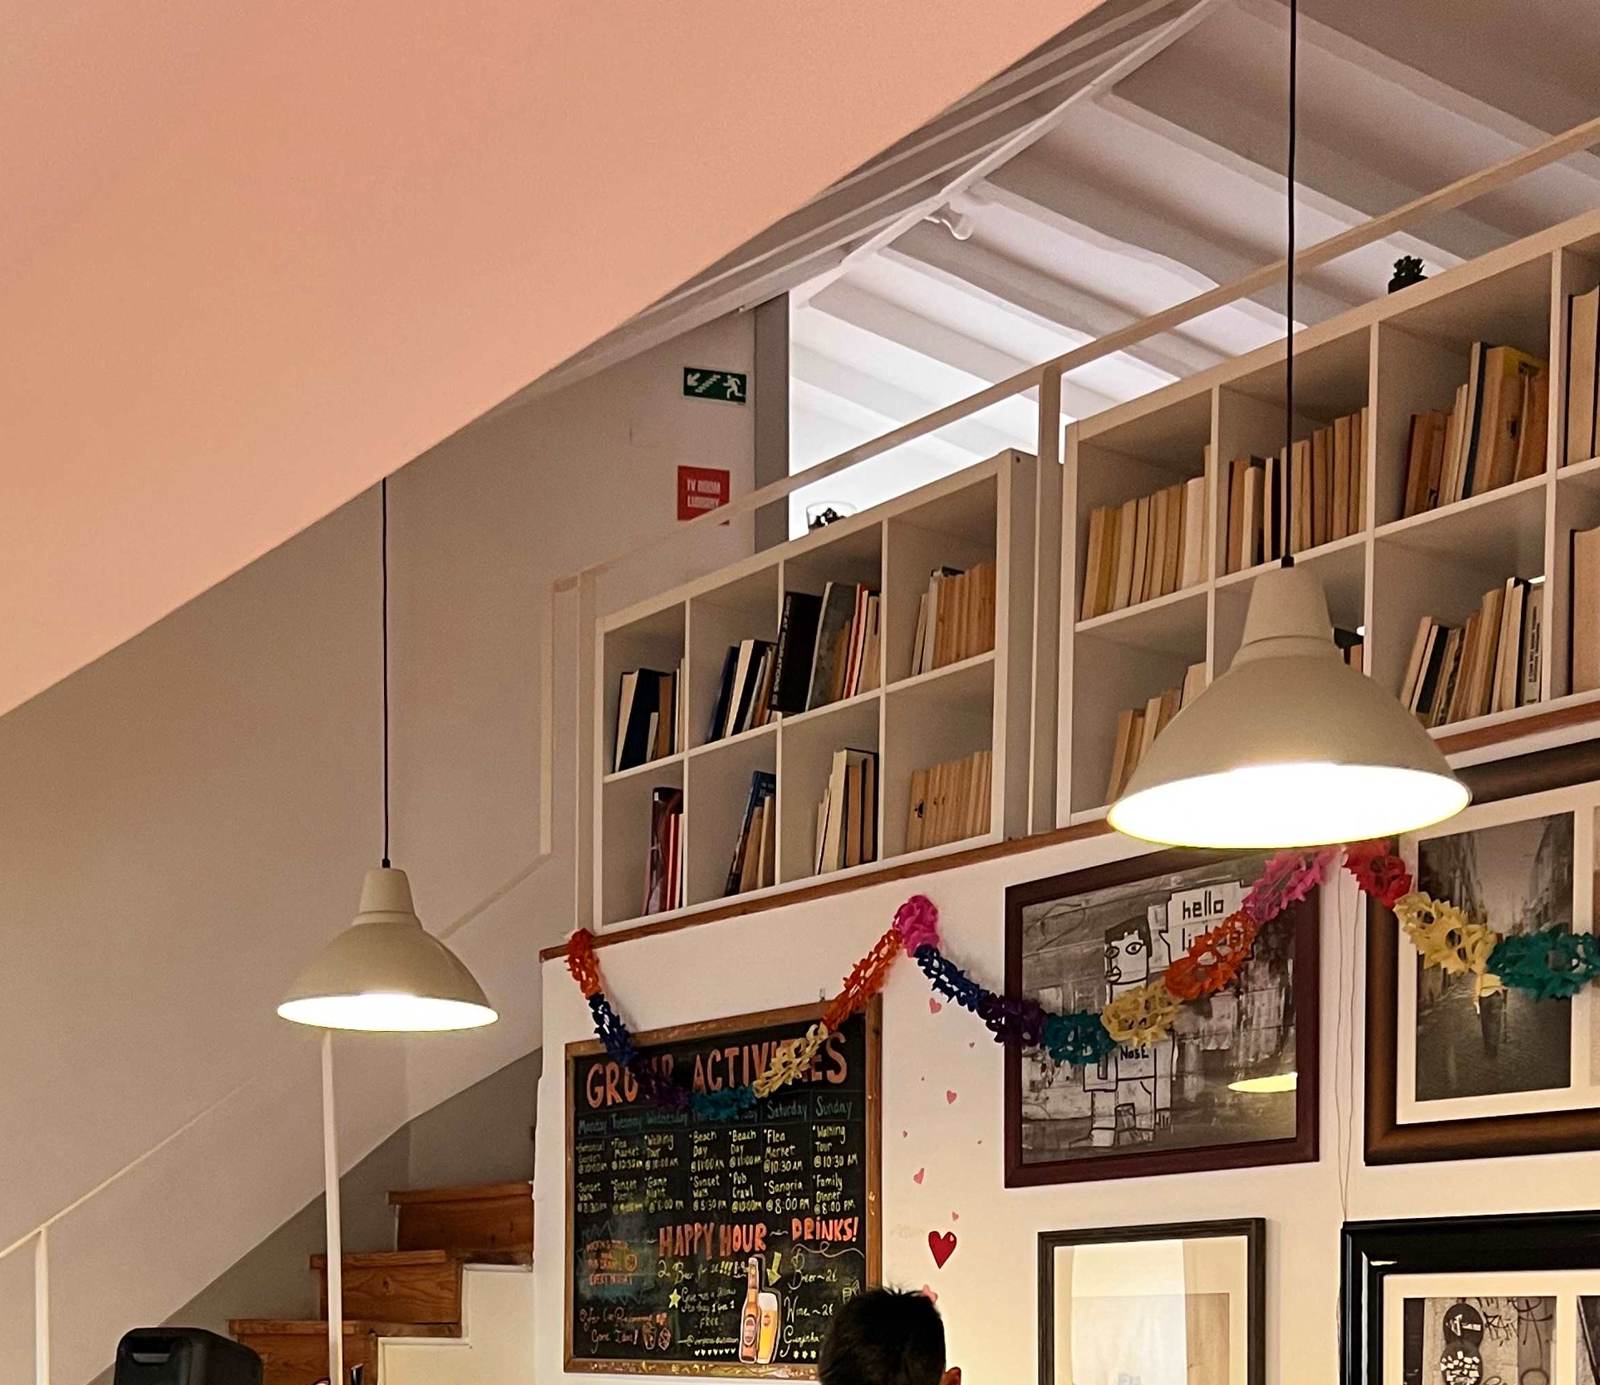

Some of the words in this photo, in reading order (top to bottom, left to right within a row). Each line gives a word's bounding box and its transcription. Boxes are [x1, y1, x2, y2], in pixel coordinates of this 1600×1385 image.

[1183, 890, 1224, 920] hello
[767, 1100, 808, 1120] Saturday
[815, 1095, 852, 1120] Sunday
[732, 1129, 757, 1142] Beach
[767, 1129, 786, 1144] Flea
[847, 1153, 858, 1166] AM
[768, 1180, 804, 1197] Sangria
[816, 1173, 844, 1191] Family
[659, 1222, 715, 1260] HAPPY
[719, 1222, 767, 1257] HOUR
